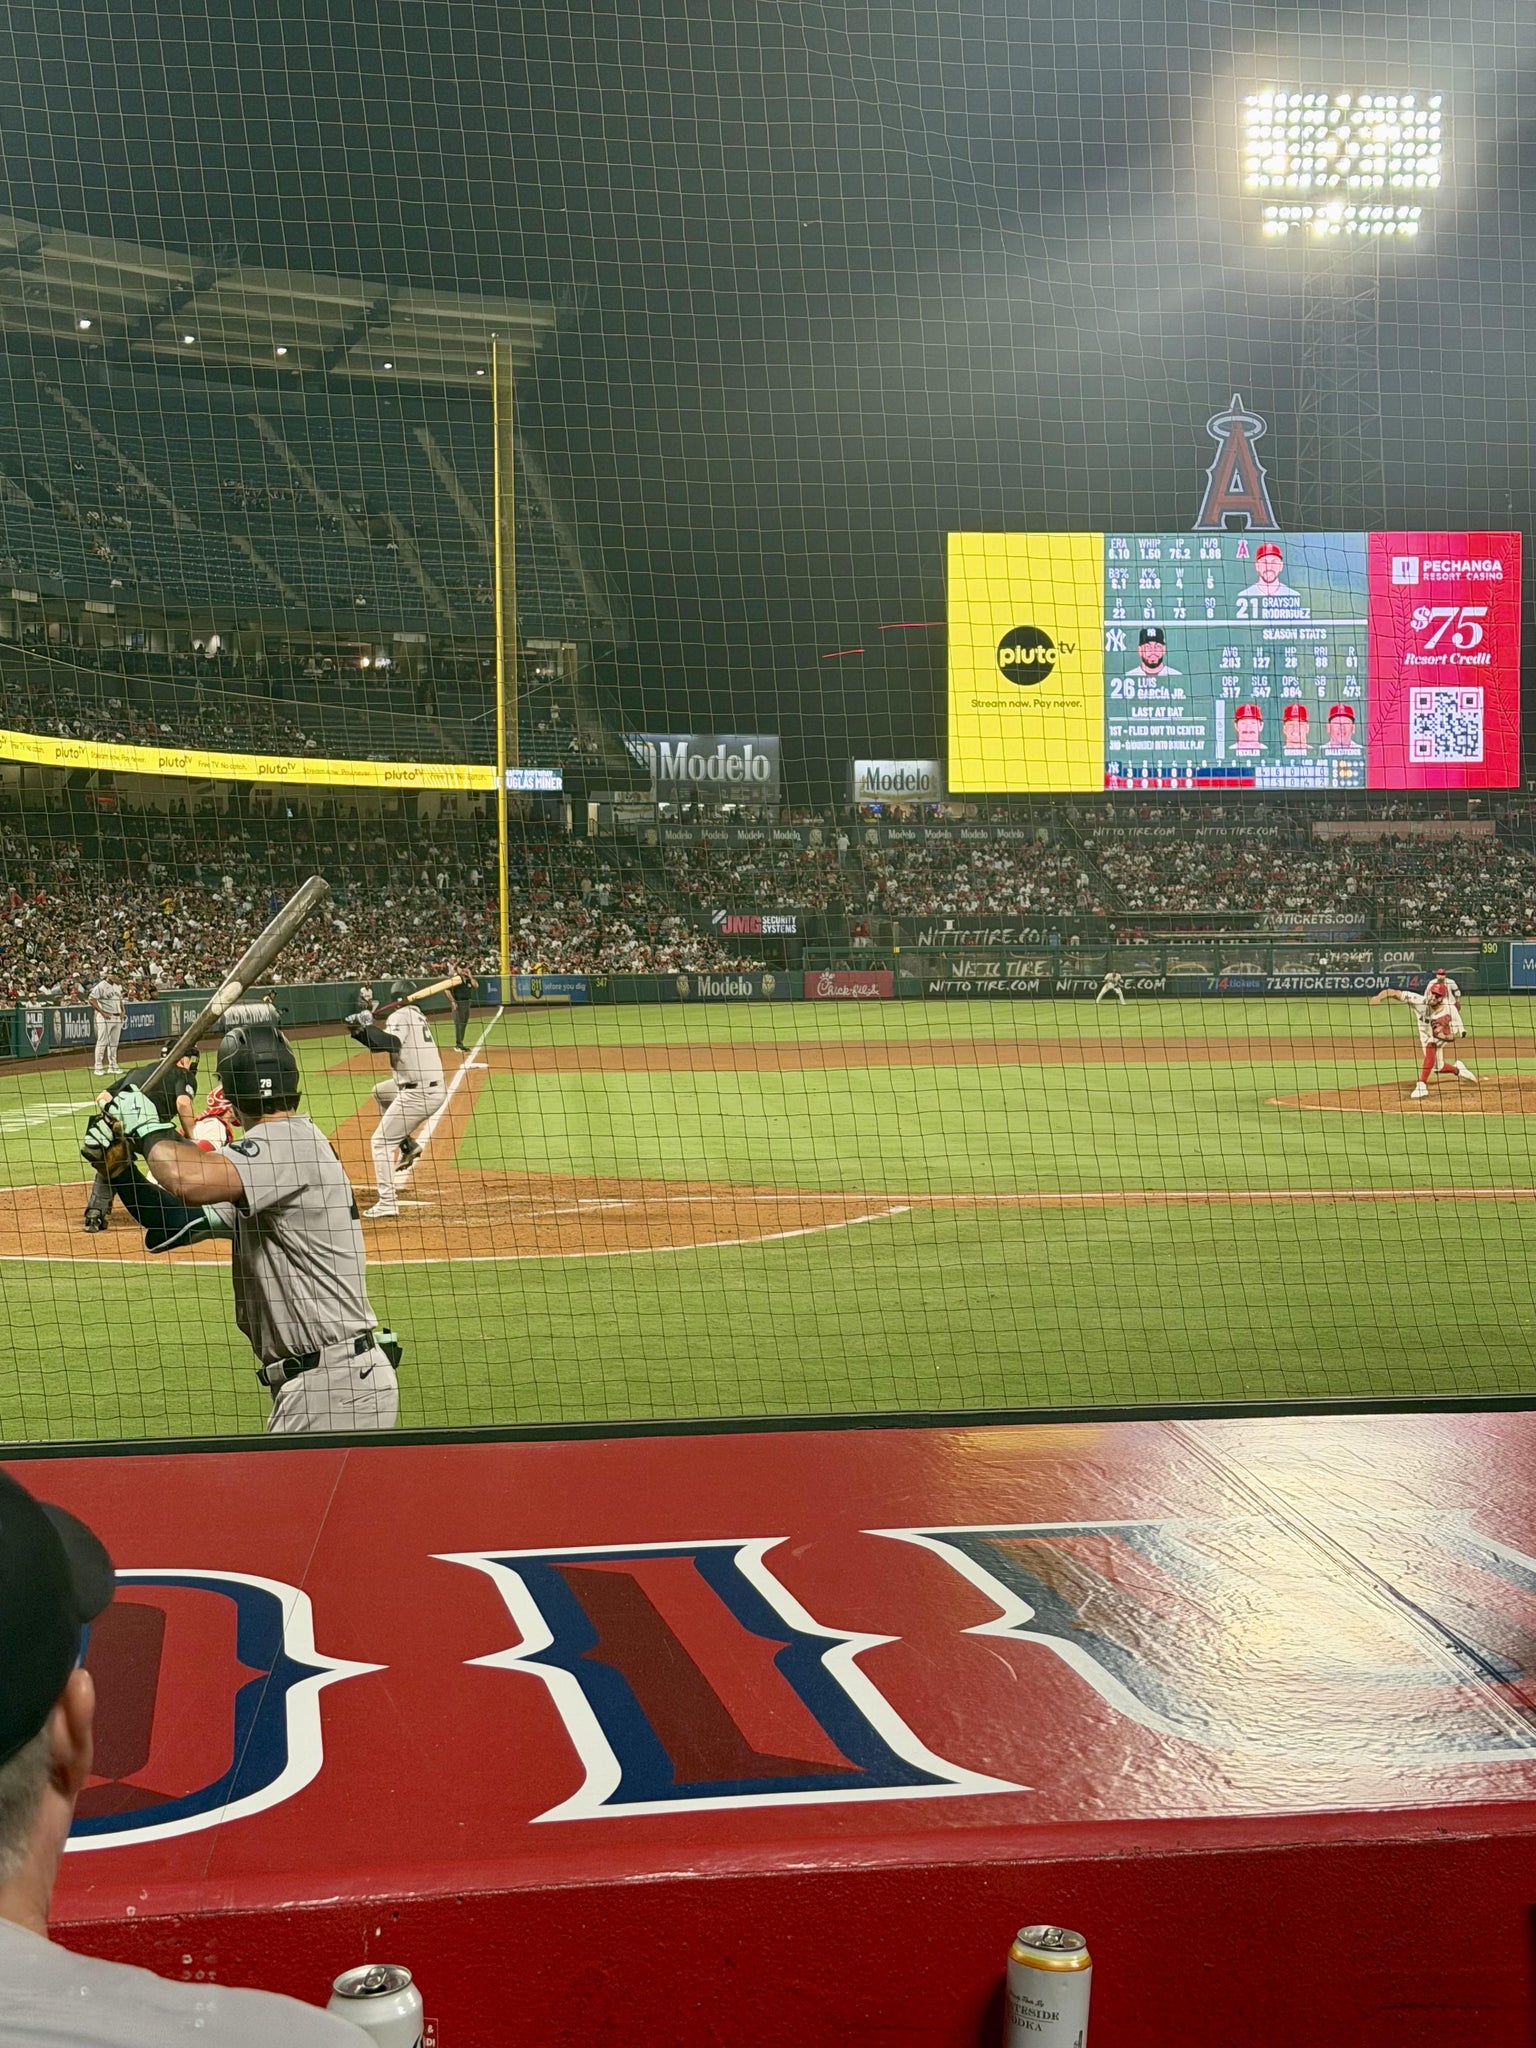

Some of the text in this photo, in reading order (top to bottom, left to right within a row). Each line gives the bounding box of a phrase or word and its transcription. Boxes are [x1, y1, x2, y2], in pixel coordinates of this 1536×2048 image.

[1192, 393, 1281, 530] A
[1111, 538, 1127, 548] ERA
[1139, 538, 1160, 548] WHIP
[1175, 538, 1184, 548] IP
[1203, 538, 1218, 548] H/9
[1423, 560, 1502, 572] PECHANGA
[1142, 568, 1156, 578] K%
[1175, 568, 1184, 578] W
[1207, 568, 1213, 578] L
[1466, 572, 1504, 580] CASINO
[1262, 597, 1300, 608] GRAYSON
[1112, 608, 1126, 619] 22
[1236, 598, 1259, 619] 21
[1262, 608, 1311, 619] RODRIGUEZ
[1410, 605, 1488, 649] $75
[1263, 629, 1327, 640] SEASON STATS
[999, 641, 1075, 668] pluto tv
[1404, 653, 1492, 665] Resort Credit
[1253, 657, 1270, 668] 127
[1137, 677, 1157, 688] LUIS
[1251, 676, 1268, 686] SLG
[1346, 676, 1357, 686] PA
[1110, 678, 1136, 699] 26
[1342, 686, 1361, 698] 473
[971, 699, 1007, 708] Stream
[1033, 699, 1051, 709] Pay
[1131, 707, 1153, 717] LAST
[1154, 707, 1165, 717] AT
[1150, 725, 1164, 736] OUT
[1177, 725, 1206, 736] CENTER
[55, 747, 79, 759] pluto
[158, 756, 186, 769] pluto
[258, 764, 288, 775] pluto
[287, 762, 296, 770] tv
[384, 770, 416, 781] pluto
[659, 741, 771, 781] Modelo
[866, 767, 930, 791] Modelo
[665, 830, 692, 840] Modelo
[701, 829, 729, 839] Modelo
[737, 830, 764, 839] Modelo
[773, 829, 801, 840] Modelo
[888, 829, 916, 840] Modelo
[961, 829, 988, 839] Modelo
[997, 829, 1024, 839] Modelo
[1092, 827, 1124, 837] NITTO
[1195, 826, 1227, 836] NITTO
[721, 915, 796, 934] JMG SECURITY
[1262, 914, 1365, 925] 714TICKETS.COM
[762, 924, 797, 934] SYSTEMS
[1482, 943, 1498, 954] 390
[576, 983, 586, 991] dig
[697, 976, 753, 997] Modelo
[929, 979, 1040, 993] NITTO TIRE.COM
[1056, 979, 1098, 992] NITTO
[1266, 977, 1390, 990] 714TICKETS.COM
[26, 1012, 44, 1024] MLB
[427, 2024, 434, 2034] &
